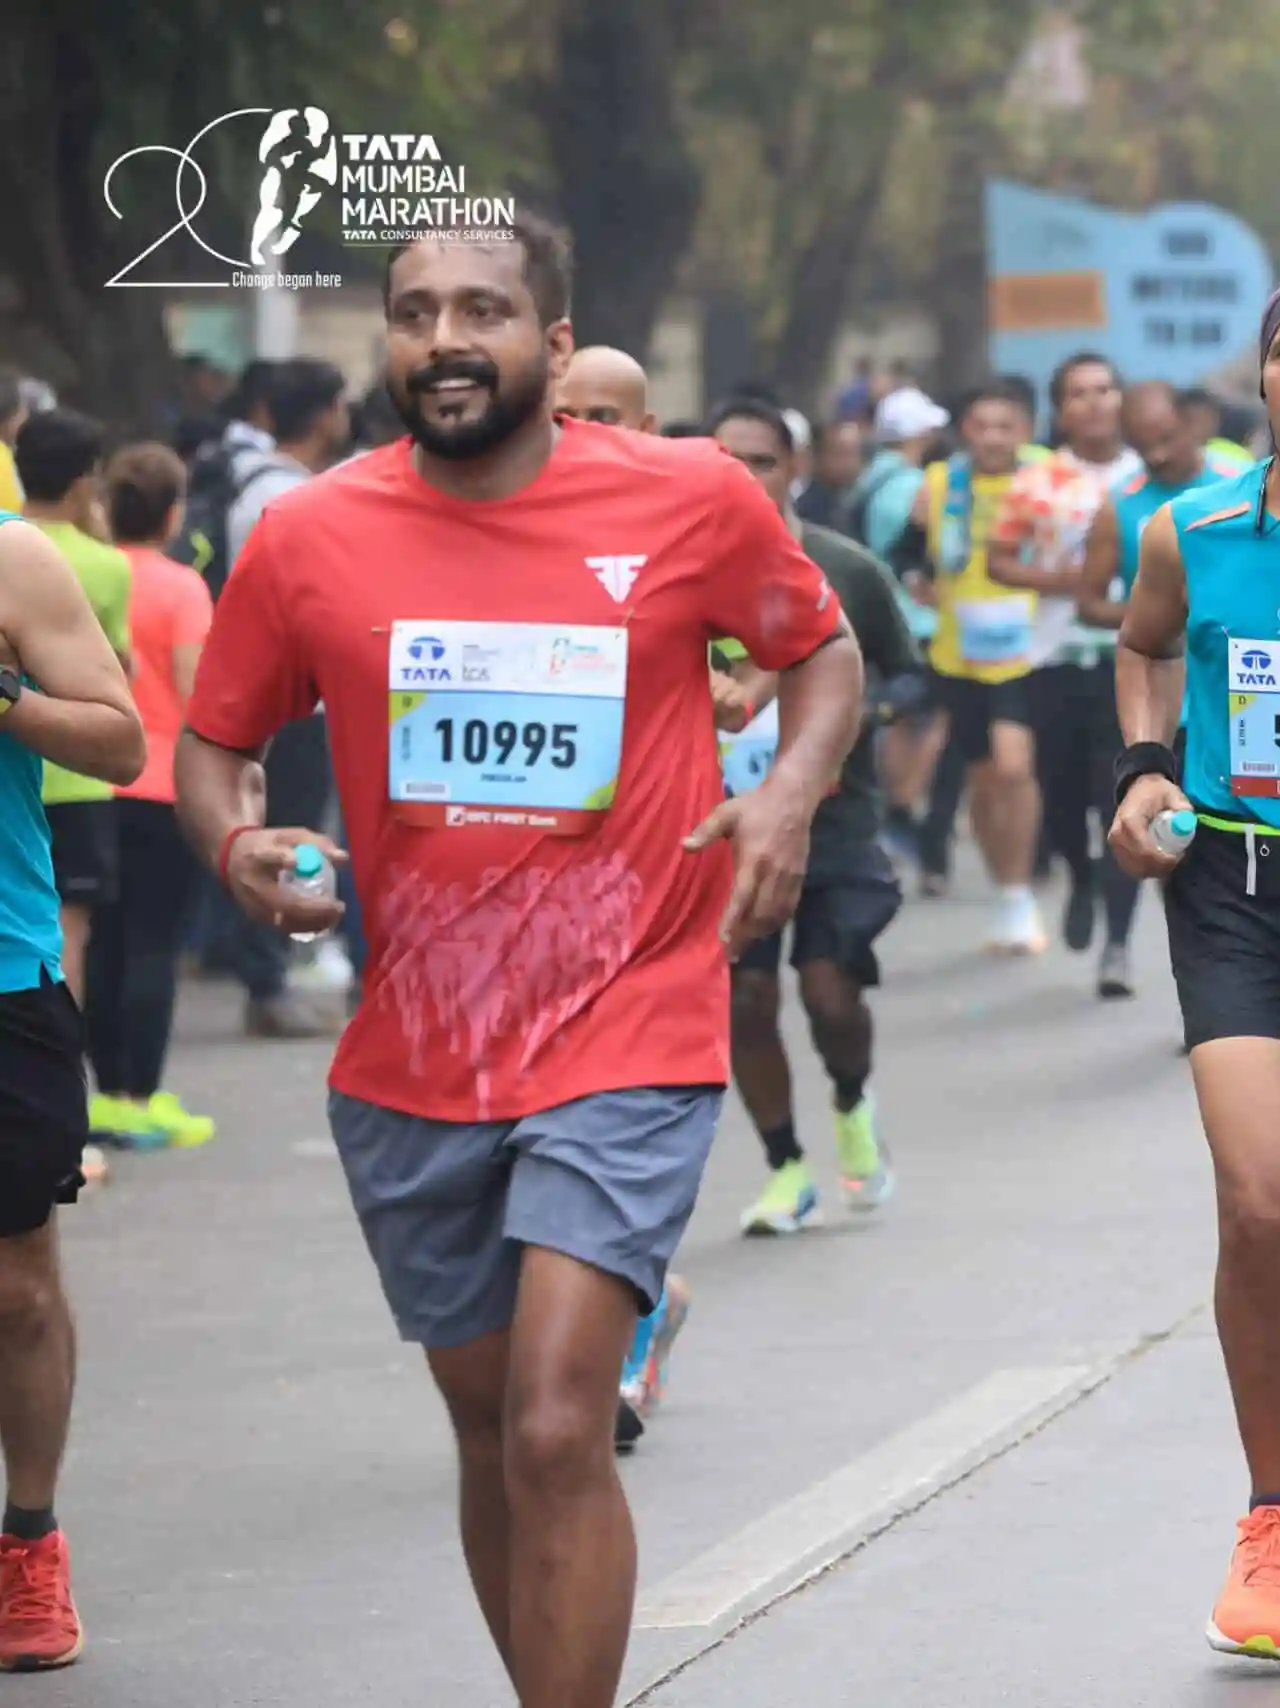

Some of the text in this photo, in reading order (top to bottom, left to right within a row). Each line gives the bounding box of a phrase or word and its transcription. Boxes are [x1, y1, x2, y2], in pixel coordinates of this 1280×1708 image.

[400, 667, 452, 682] TATA
[1236, 672, 1277, 686] TATA
[1238, 695, 1247, 705] D
[435, 717, 579, 769] 10995
